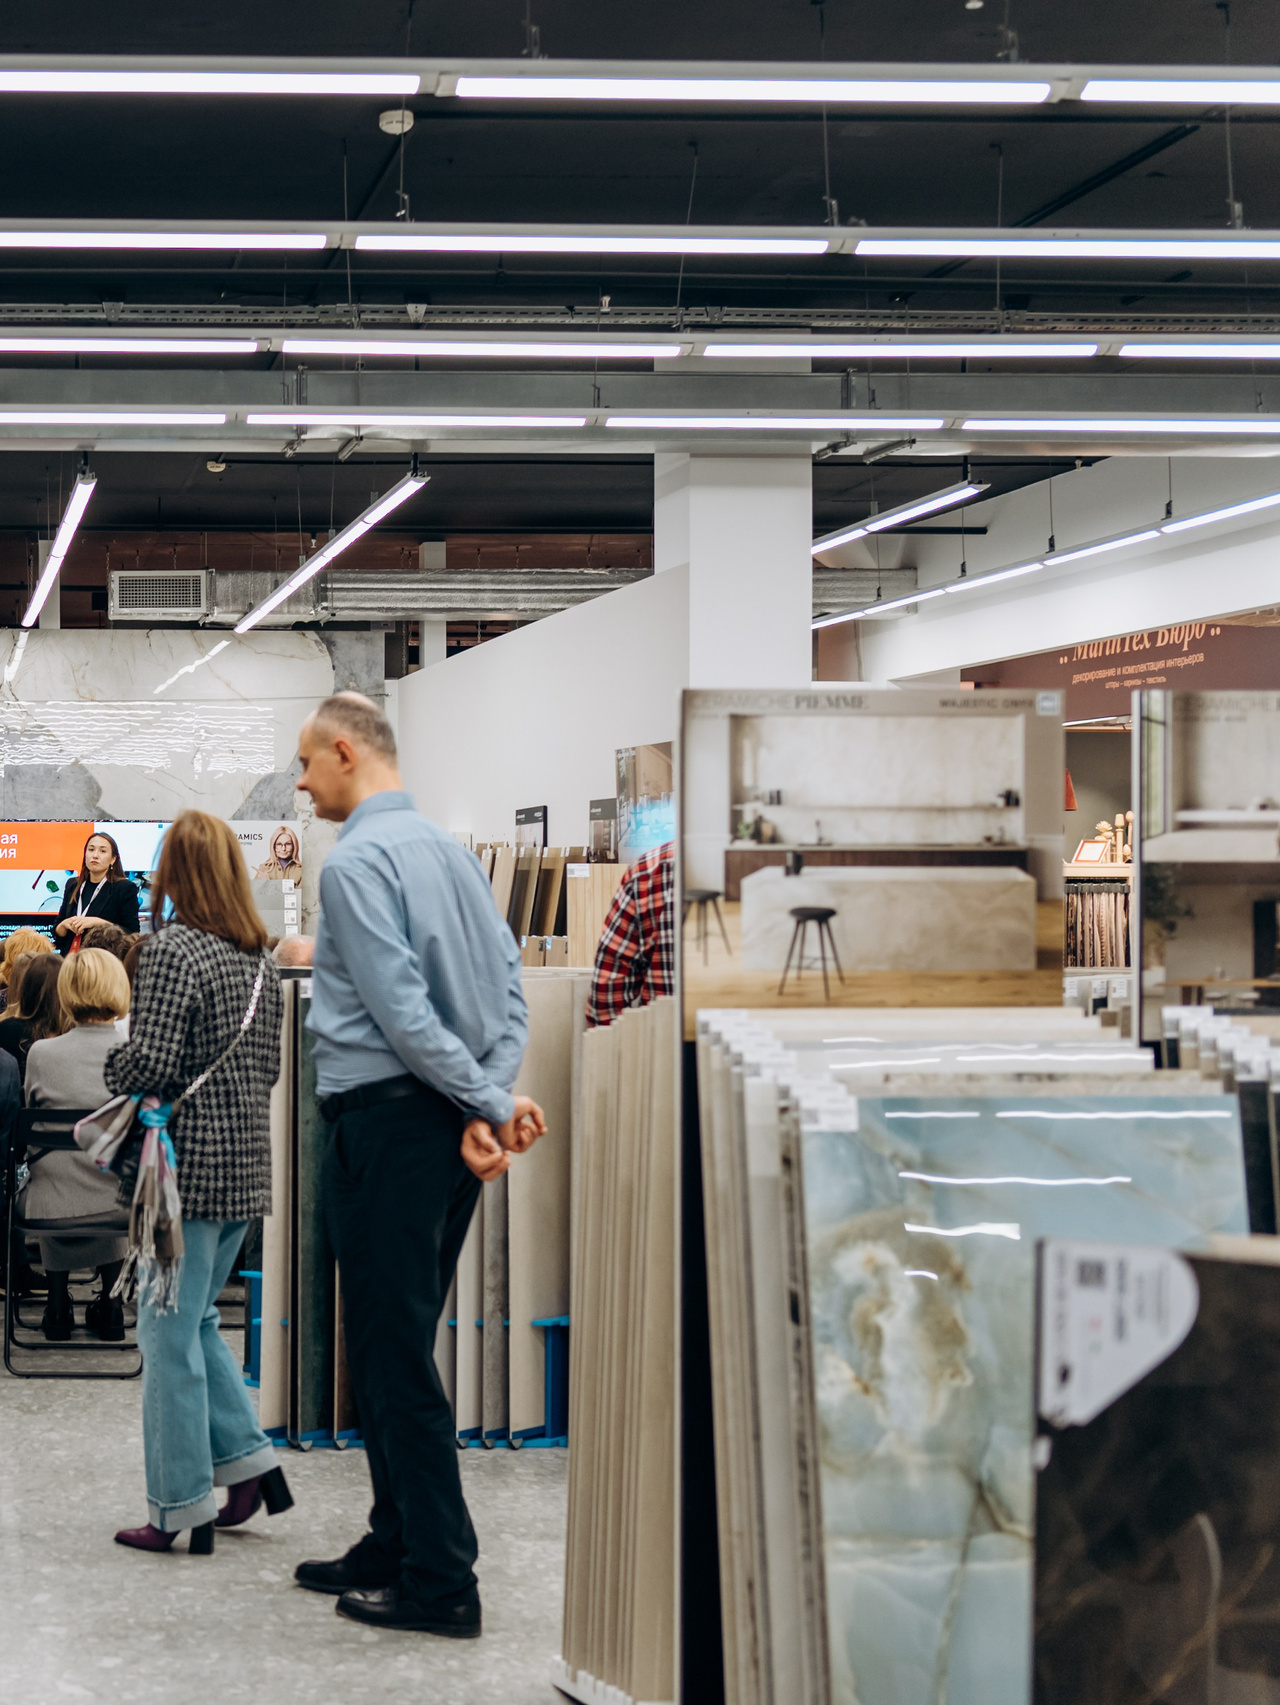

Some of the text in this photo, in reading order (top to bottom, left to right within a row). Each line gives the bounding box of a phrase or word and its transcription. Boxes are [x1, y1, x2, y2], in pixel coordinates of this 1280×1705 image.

[1072, 668, 1115, 685] декорирование
[1122, 660, 1165, 676] комплектация
[1166, 652, 1205, 669] интерьеров
[237, 833, 263, 841] AMICS
